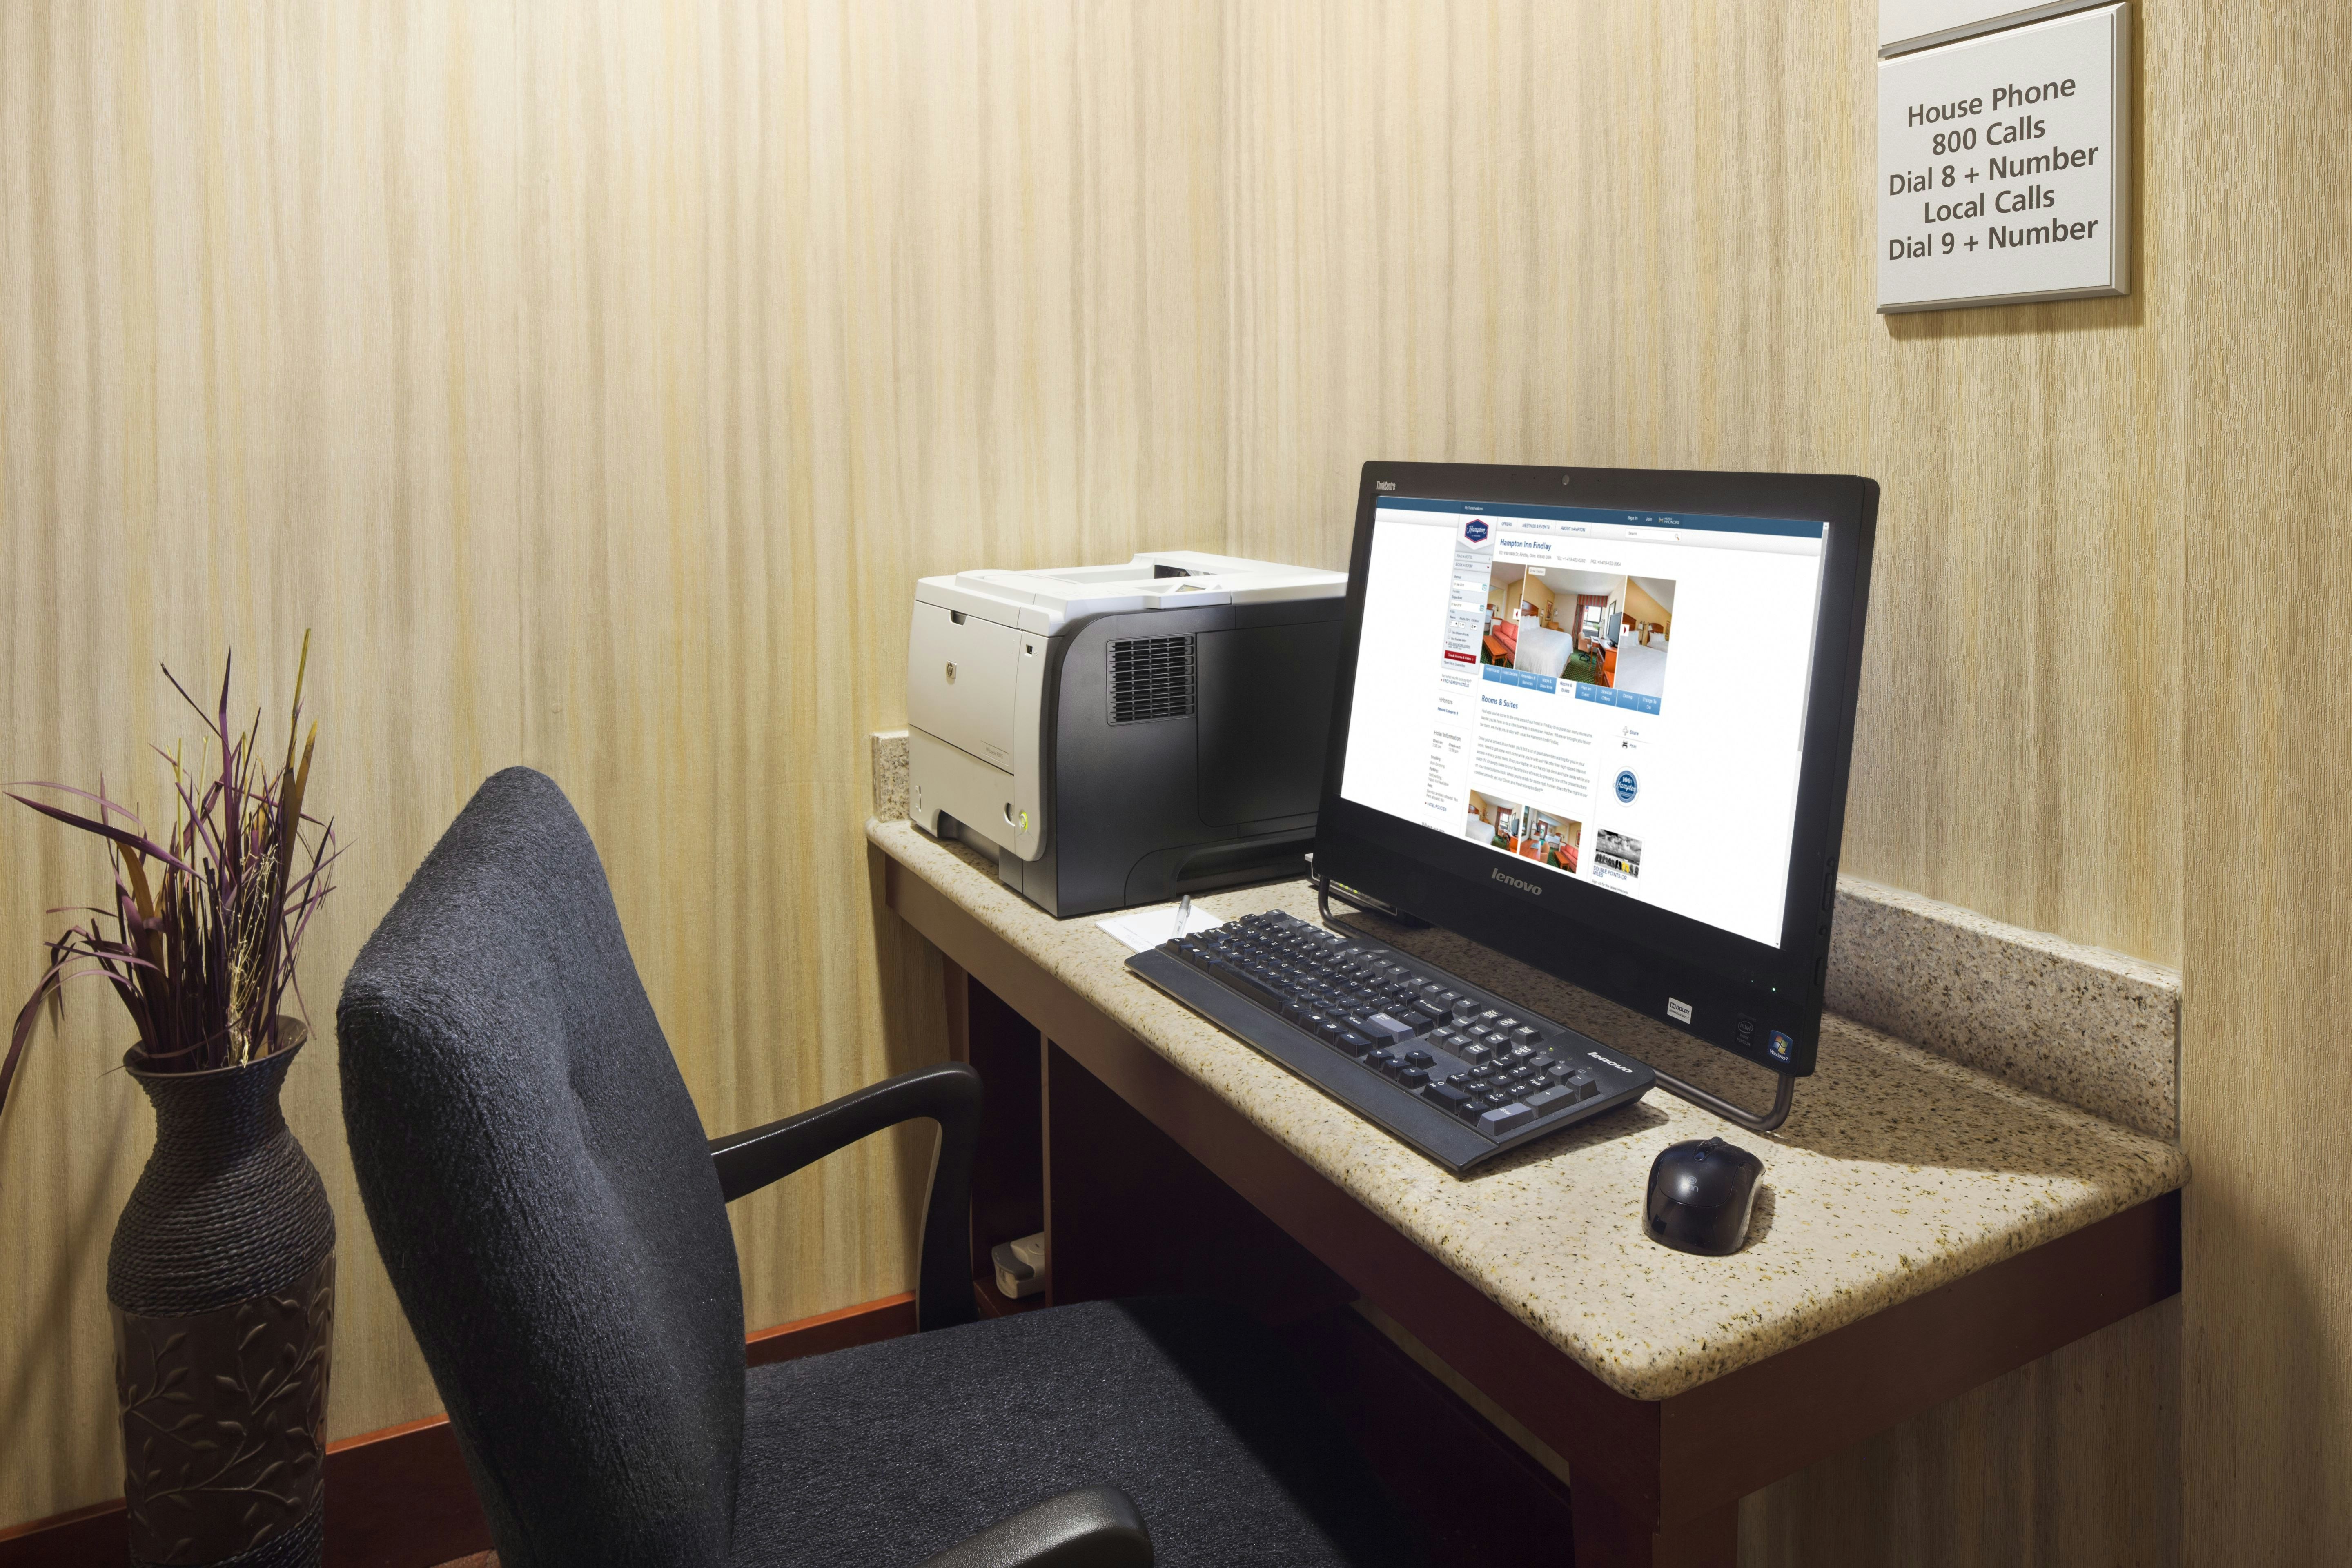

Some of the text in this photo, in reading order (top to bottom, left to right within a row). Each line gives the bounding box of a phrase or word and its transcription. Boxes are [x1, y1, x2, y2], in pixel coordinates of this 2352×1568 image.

[1908, 78, 2076, 127] House Phone
[1932, 115, 2046, 155] 800 Calls
[1890, 146, 2098, 196] Dial 8 + Number
[1924, 184, 2055, 223] Local Calls
[1889, 218, 2098, 261] Dial 9 + Number
[1376, 481, 1396, 490] ThinkCentre
[1466, 525, 1487, 535] Hampton
[1499, 538, 1523, 548] Hampton
[1532, 541, 1552, 551] Findlay
[1481, 695, 1497, 704] Rooms
[1503, 699, 1518, 709] Suites
[1443, 732, 1461, 742] Information
[1613, 780, 1638, 794] Hampton
[1593, 865, 1607, 874] DOUBLE
[1607, 870, 1621, 879] POINTS
[1492, 868, 1542, 895] lenovo
[1676, 1005, 1690, 1015] DOLBY
[1737, 1038, 1751, 1047] PENTIUM
[1770, 1049, 1785, 1060] Windows
[1587, 1052, 1633, 1073] lenovo
